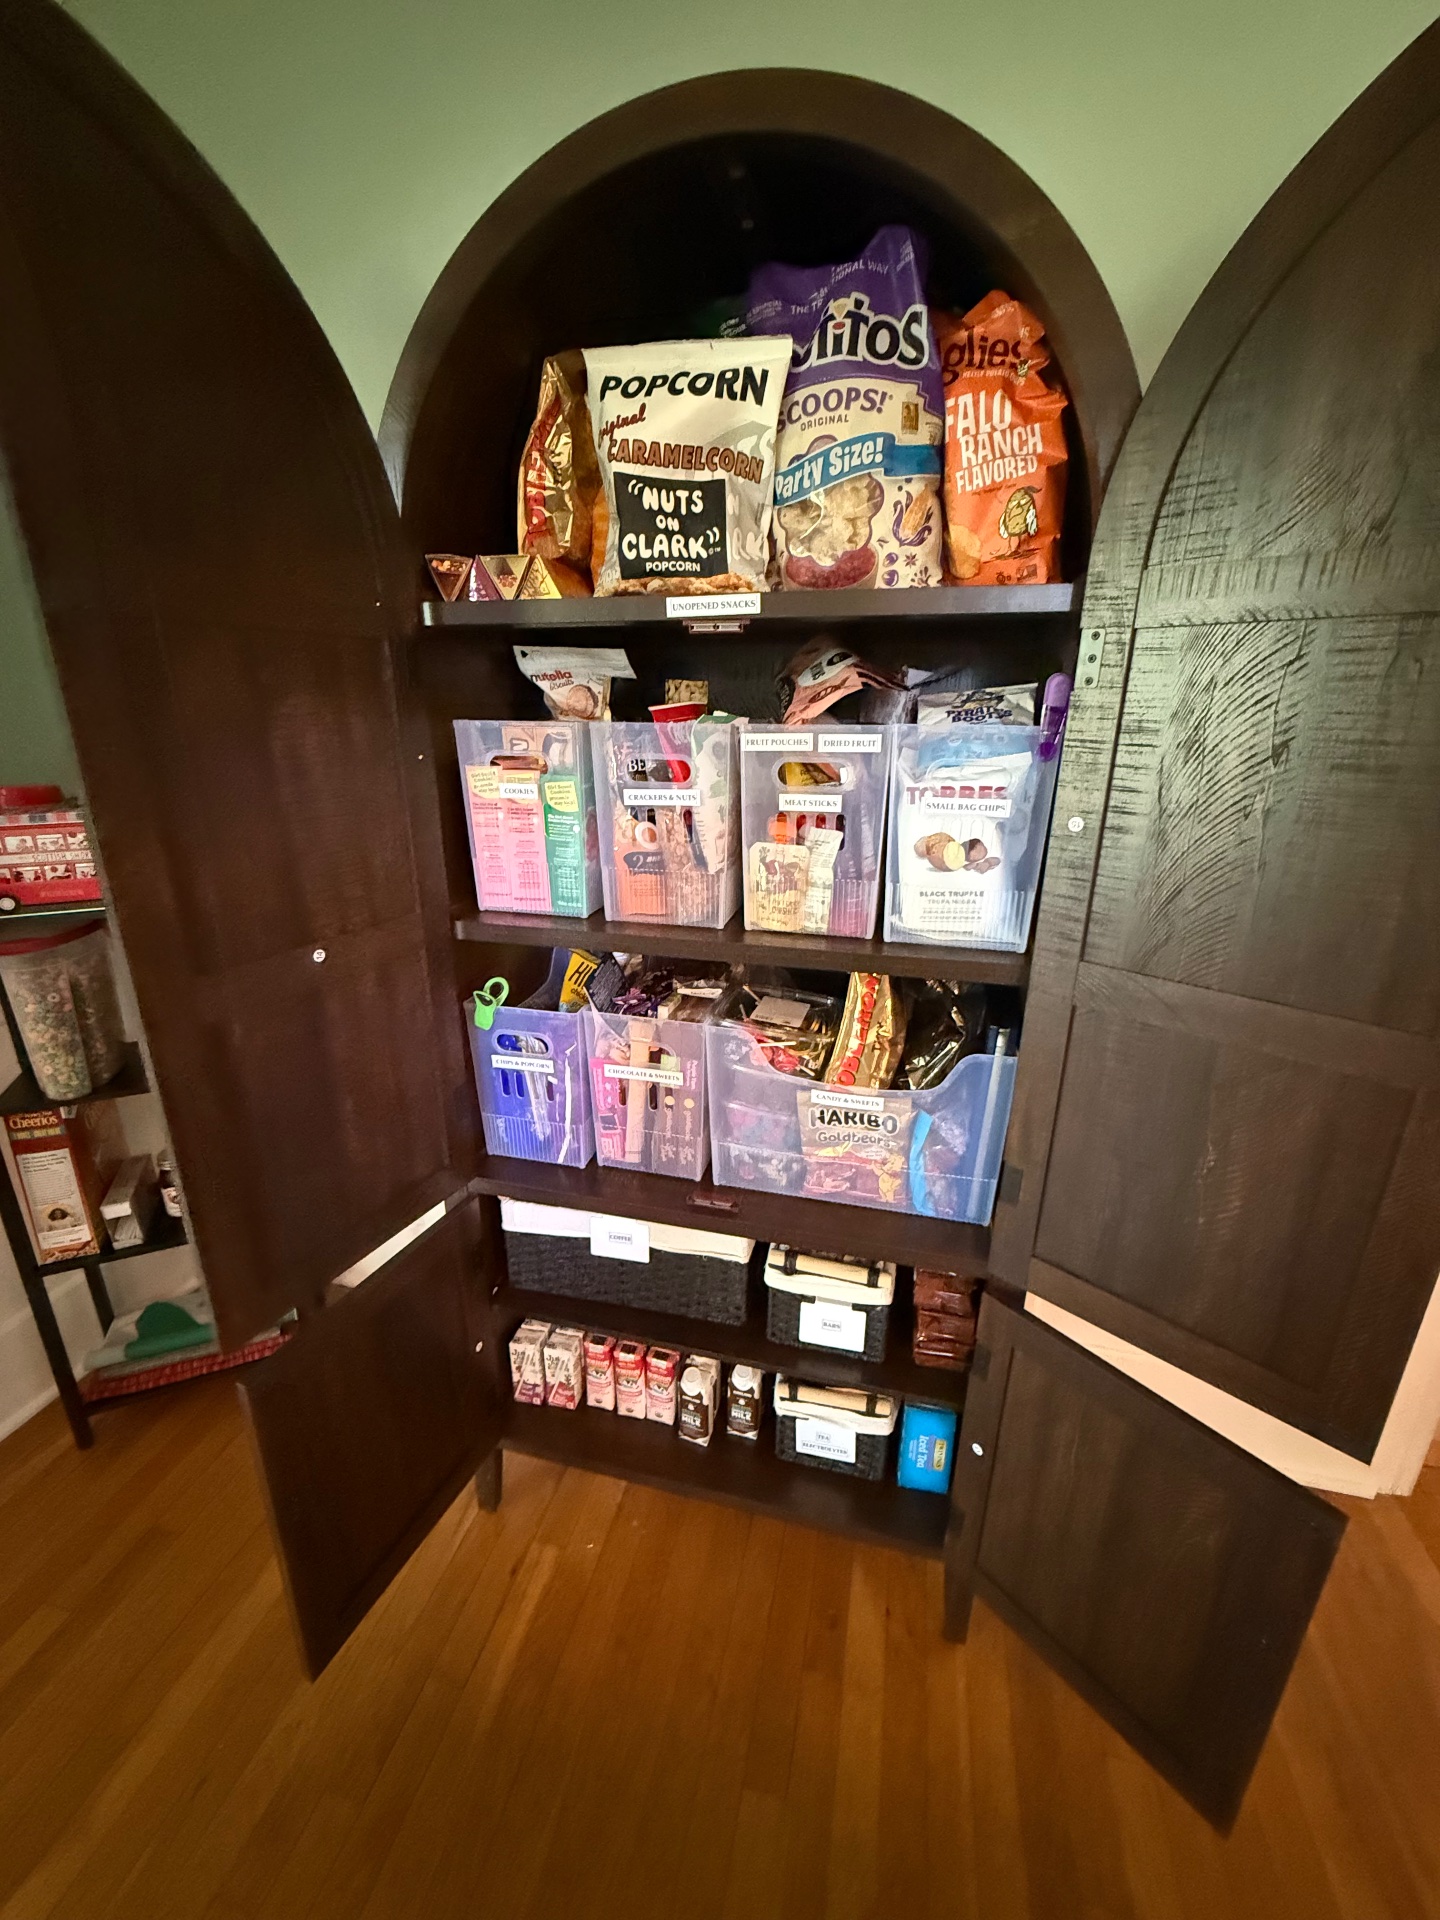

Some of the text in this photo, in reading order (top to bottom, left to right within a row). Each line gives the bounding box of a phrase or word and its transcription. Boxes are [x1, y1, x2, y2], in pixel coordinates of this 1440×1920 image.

[943, 326, 1030, 387] glies
[600, 366, 769, 407] POPCORN
[600, 402, 647, 440] riginal
[800, 414, 850, 432] ORIGINAL
[960, 423, 1044, 468] RANCH
[775, 437, 884, 500] Party Size!
[955, 454, 1038, 495] FLAVORED
[655, 514, 680, 532] ON
[645, 560, 701, 572] POPCORN
[672, 599, 756, 612] UNOPENED SNACKS
[530, 669, 573, 684] nutella
[746, 738, 809, 746] FRUIT POUCHES
[823, 739, 877, 747] DRIED FRUIT
[504, 787, 534, 795] COOKIES
[784, 799, 838, 808] MEAT STICKS
[926, 802, 1006, 813] SMALL BAG CHIPS
[919, 890, 985, 898] BLACK TRUFFLE
[495, 1058, 514, 1066] CHIPS
[520, 1061, 550, 1069] POPCORN
[608, 1068, 647, 1077] CHOCOLATE
[654, 1073, 680, 1082] SWEETS
[816, 1093, 842, 1103] CANDY
[850, 1098, 880, 1107] SWEETS
[9, 1114, 59, 1130] Cheerios
[810, 1108, 898, 1135] HARIBO
[817, 1131, 891, 1147] Goldbears
[916, 1434, 929, 1469] Iced Tea
